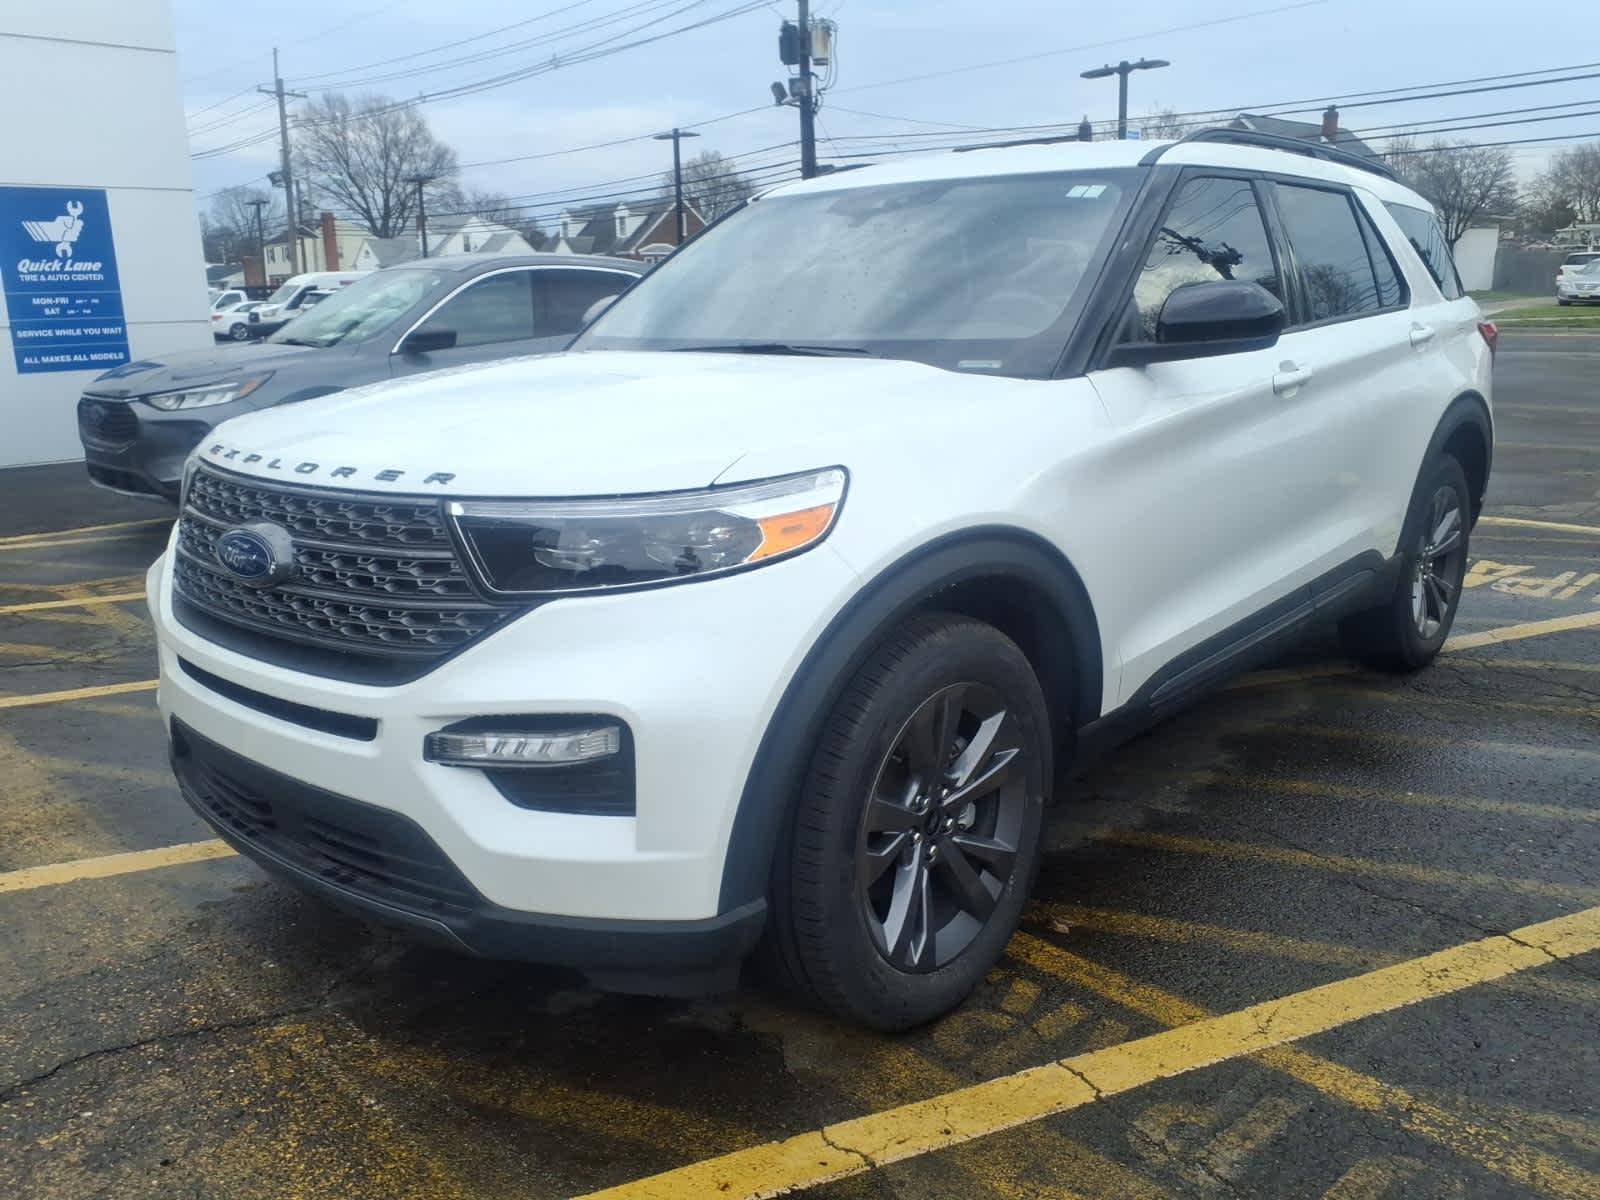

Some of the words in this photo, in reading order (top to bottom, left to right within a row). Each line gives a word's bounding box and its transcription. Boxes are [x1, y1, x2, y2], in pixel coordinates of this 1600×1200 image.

[17, 259, 62, 273] Quick
[64, 259, 102, 271] Lane
[32, 297, 69, 305] MON-FRI
[44, 307, 60, 315] SAT
[17, 330, 54, 338] SERVICE
[55, 328, 81, 336] WHILE
[102, 327, 122, 335] WAIT
[41, 355, 72, 363] MAKES
[90, 353, 124, 361] MODELS
[209, 444, 457, 485] EXPLORER
